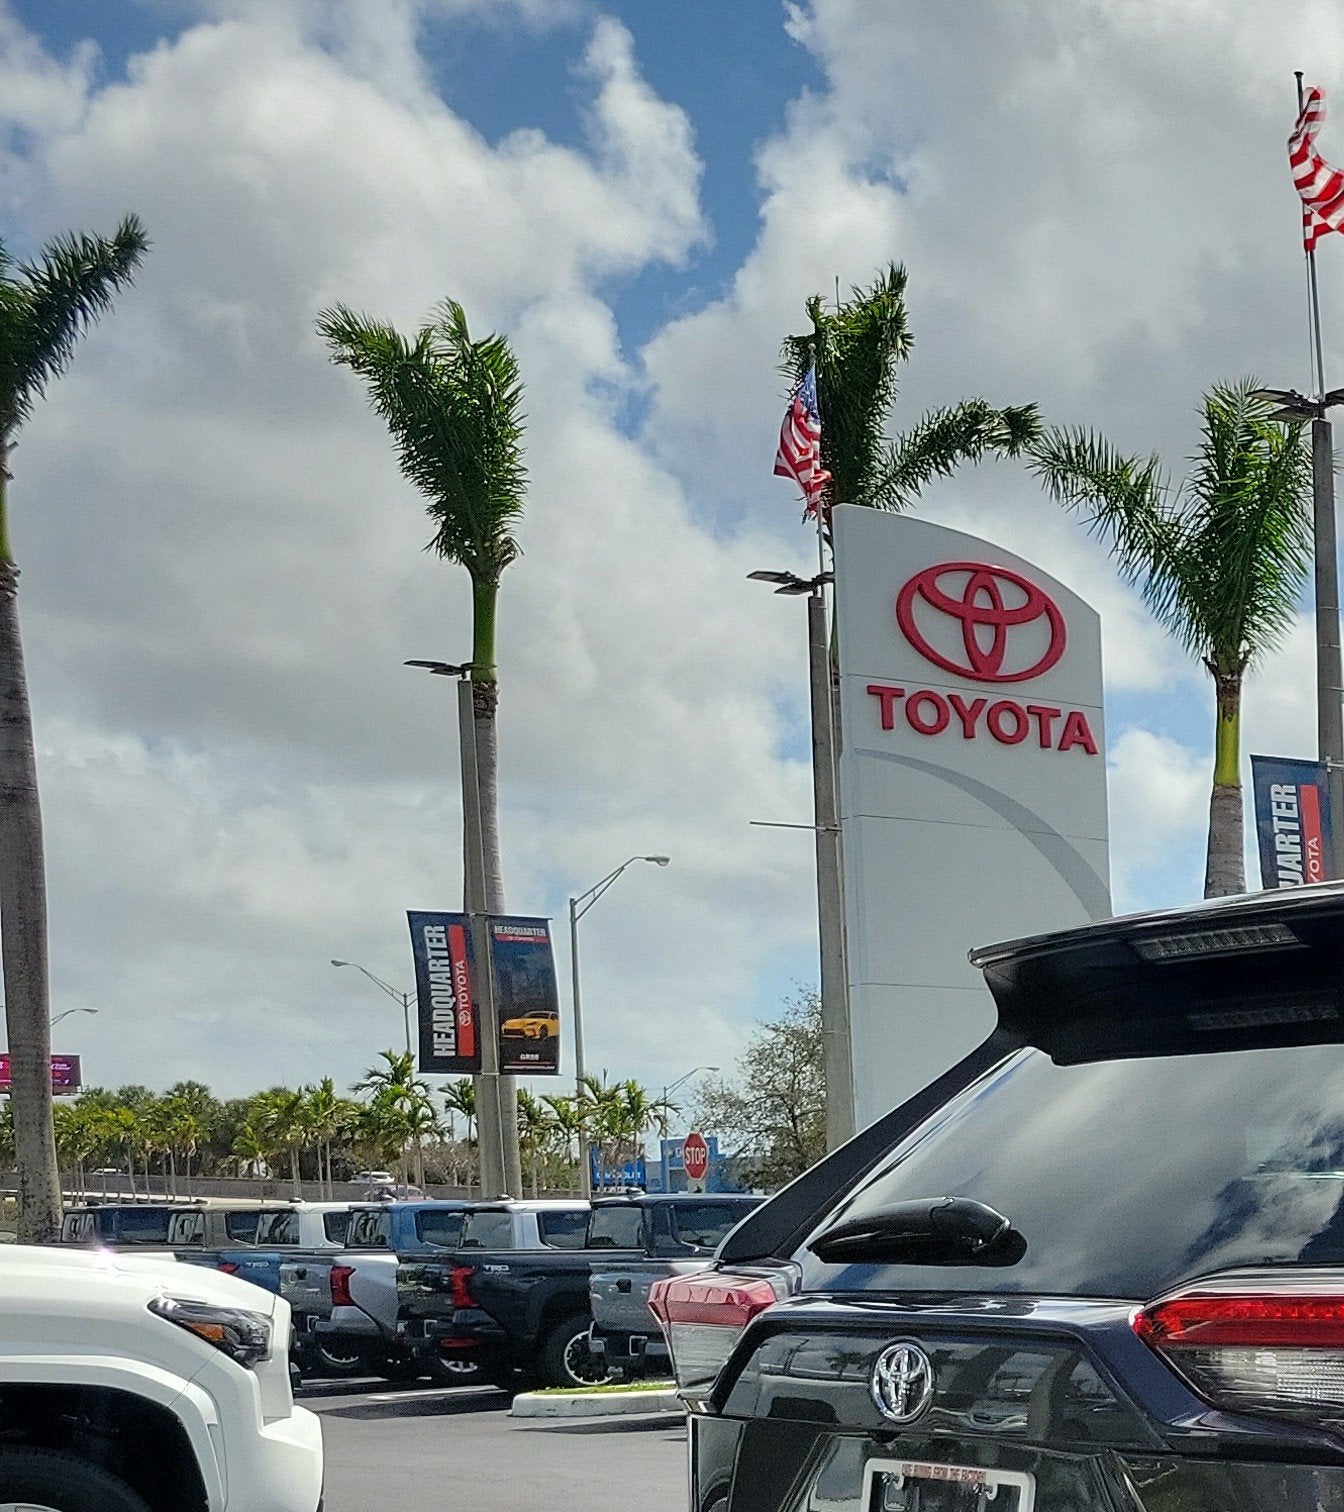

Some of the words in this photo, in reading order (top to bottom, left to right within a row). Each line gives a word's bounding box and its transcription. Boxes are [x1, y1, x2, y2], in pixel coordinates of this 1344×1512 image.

[867, 684, 1099, 755] TOYOTA
[494, 925, 546, 937] HEADQUARTER
[424, 925, 456, 1056] HEADQUARTER
[455, 961, 469, 1009] TOYOTA
[685, 1147, 706, 1165] STOP
